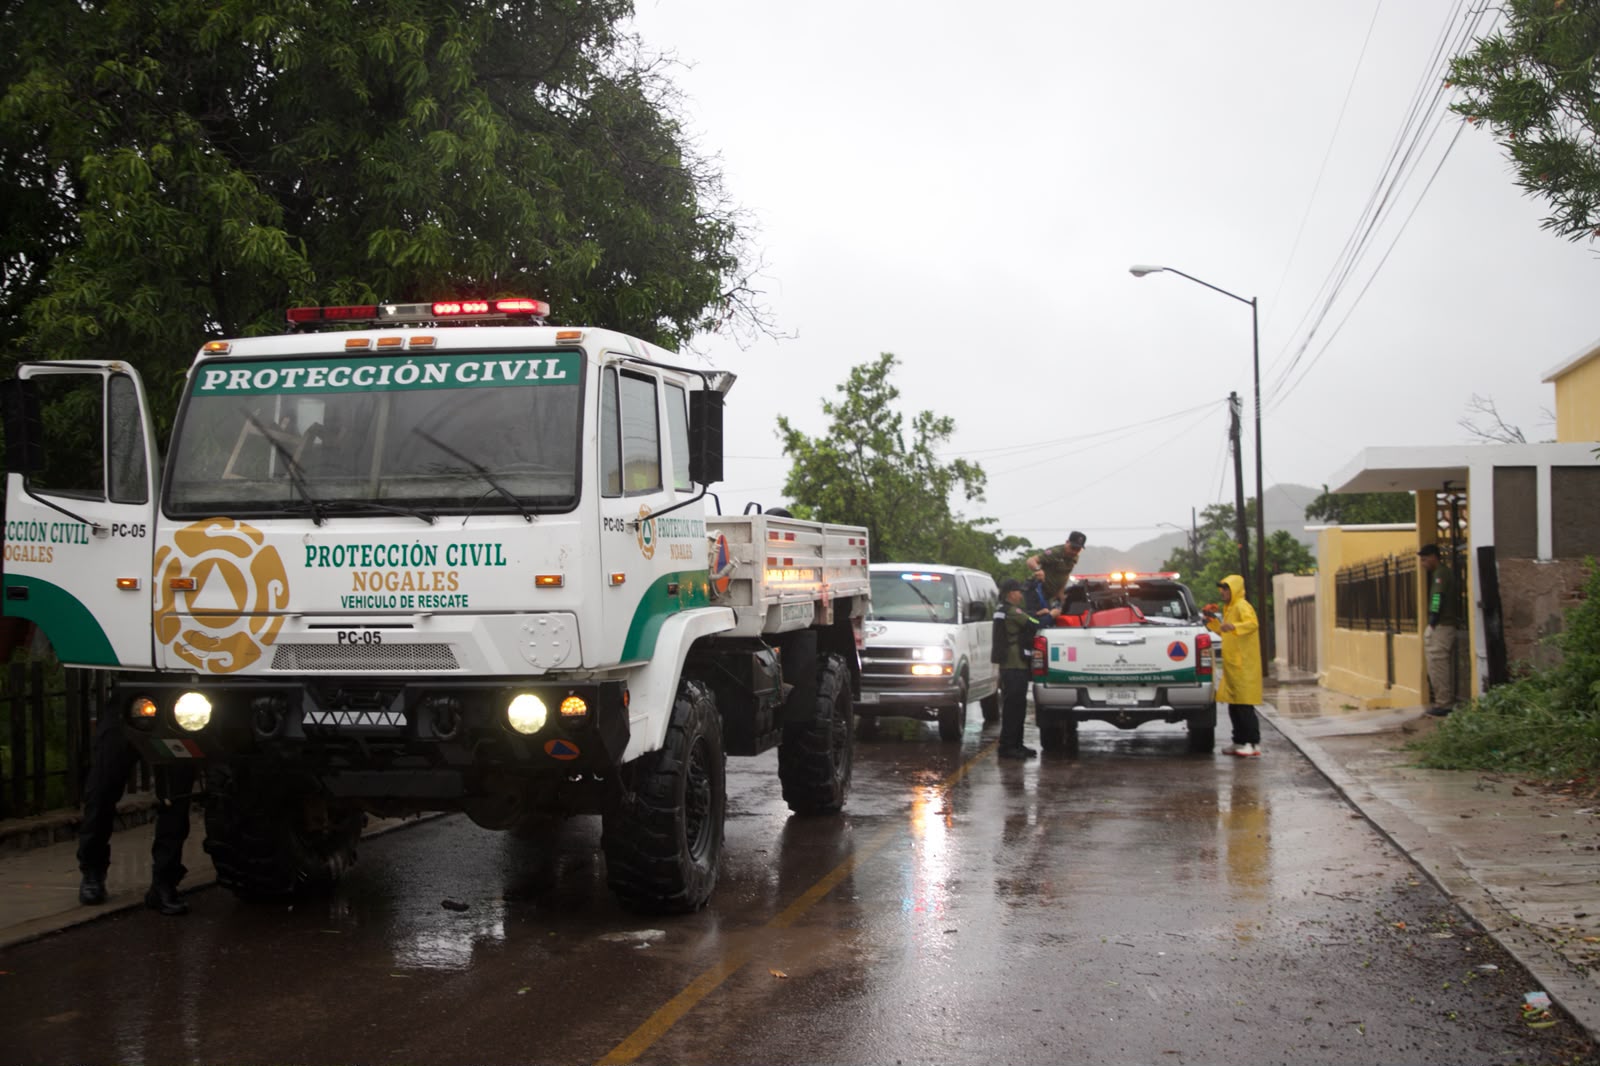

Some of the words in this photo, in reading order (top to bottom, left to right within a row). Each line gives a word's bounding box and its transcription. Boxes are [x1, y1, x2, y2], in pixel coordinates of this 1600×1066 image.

[200, 359, 455, 391] PROTECCIÓN
[455, 358, 567, 384] CIVIL
[5, 518, 48, 542] CCIÓN
[50, 522, 89, 545] CIVIL
[111, 523, 147, 538] PC-05
[604, 518, 625, 533] PC-05
[691, 520, 706, 539] CIVIL
[305, 539, 439, 567] PROTECCIÓN
[445, 543, 507, 566] CIVIL
[352, 571, 460, 592] NOGALES
[342, 595, 397, 609] VEHICULO
[400, 595, 414, 608] DE
[417, 594, 469, 608] RESCATE
[337, 631, 382, 645] PC-05
